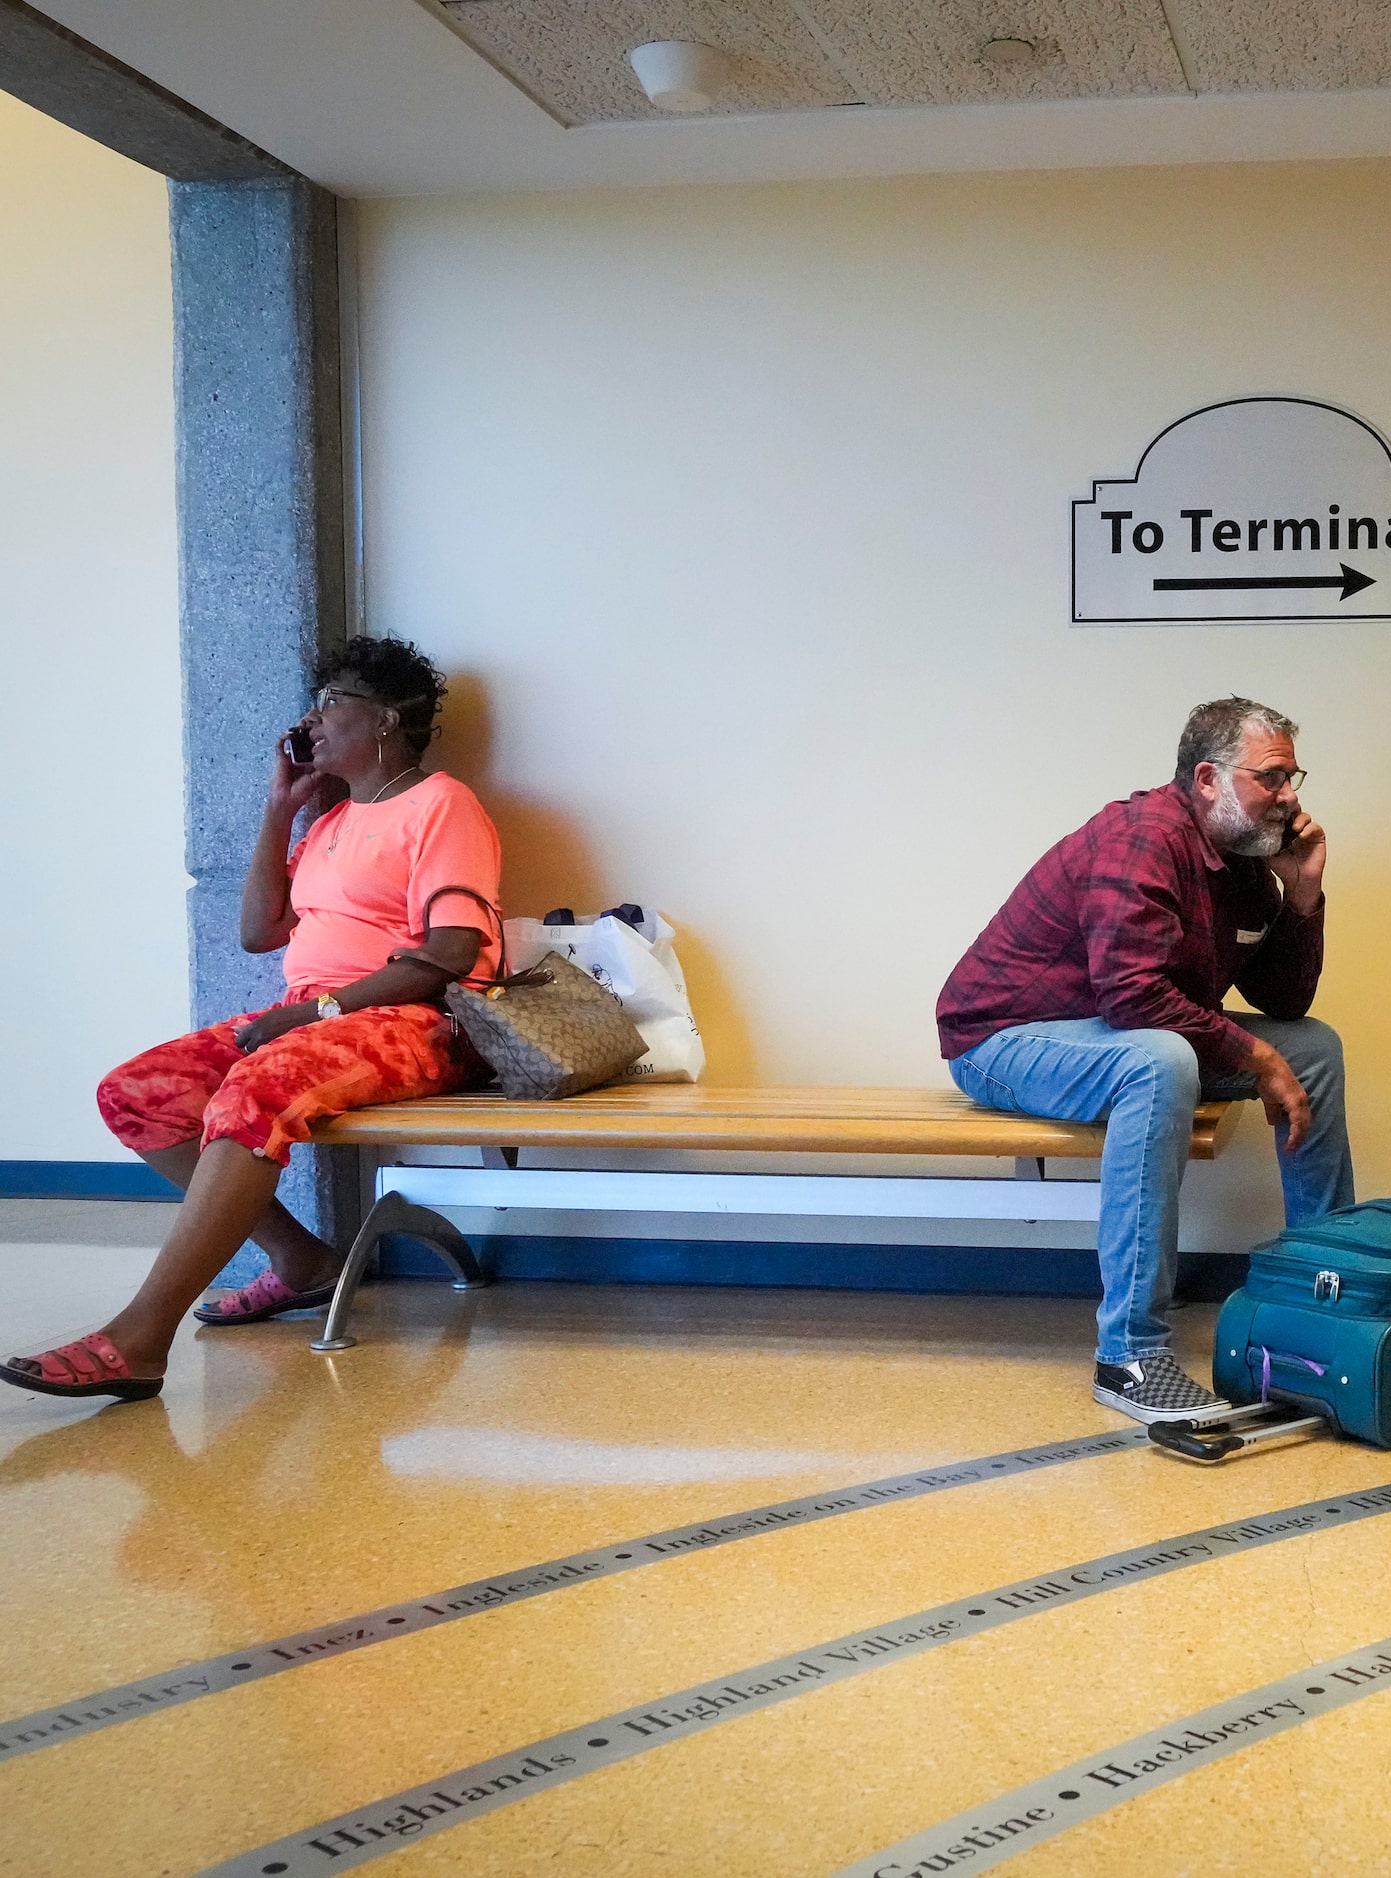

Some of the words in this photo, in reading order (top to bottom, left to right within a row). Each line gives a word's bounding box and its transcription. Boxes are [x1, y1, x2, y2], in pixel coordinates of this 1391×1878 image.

[1100, 510, 1164, 554] To
[0, 1676, 210, 1750] Industry
[266, 1627, 375, 1663] Inez
[422, 1557, 605, 1616] Ingleside
[646, 1509, 806, 1554] Ingleside
[814, 1498, 856, 1511] on
[860, 1481, 911, 1505] the
[915, 1465, 982, 1490] Bay
[1015, 1440, 1128, 1465] Ingram
[307, 1749, 578, 1859] Highlands
[621, 1661, 826, 1737] Highland
[823, 1617, 962, 1668] Village
[994, 1582, 1072, 1611] Hill
[1070, 1539, 1214, 1586] Country
[1208, 1508, 1322, 1546] Village
[872, 1807, 1055, 1878] Gustine
[1082, 1694, 1307, 1790] Hackberry
